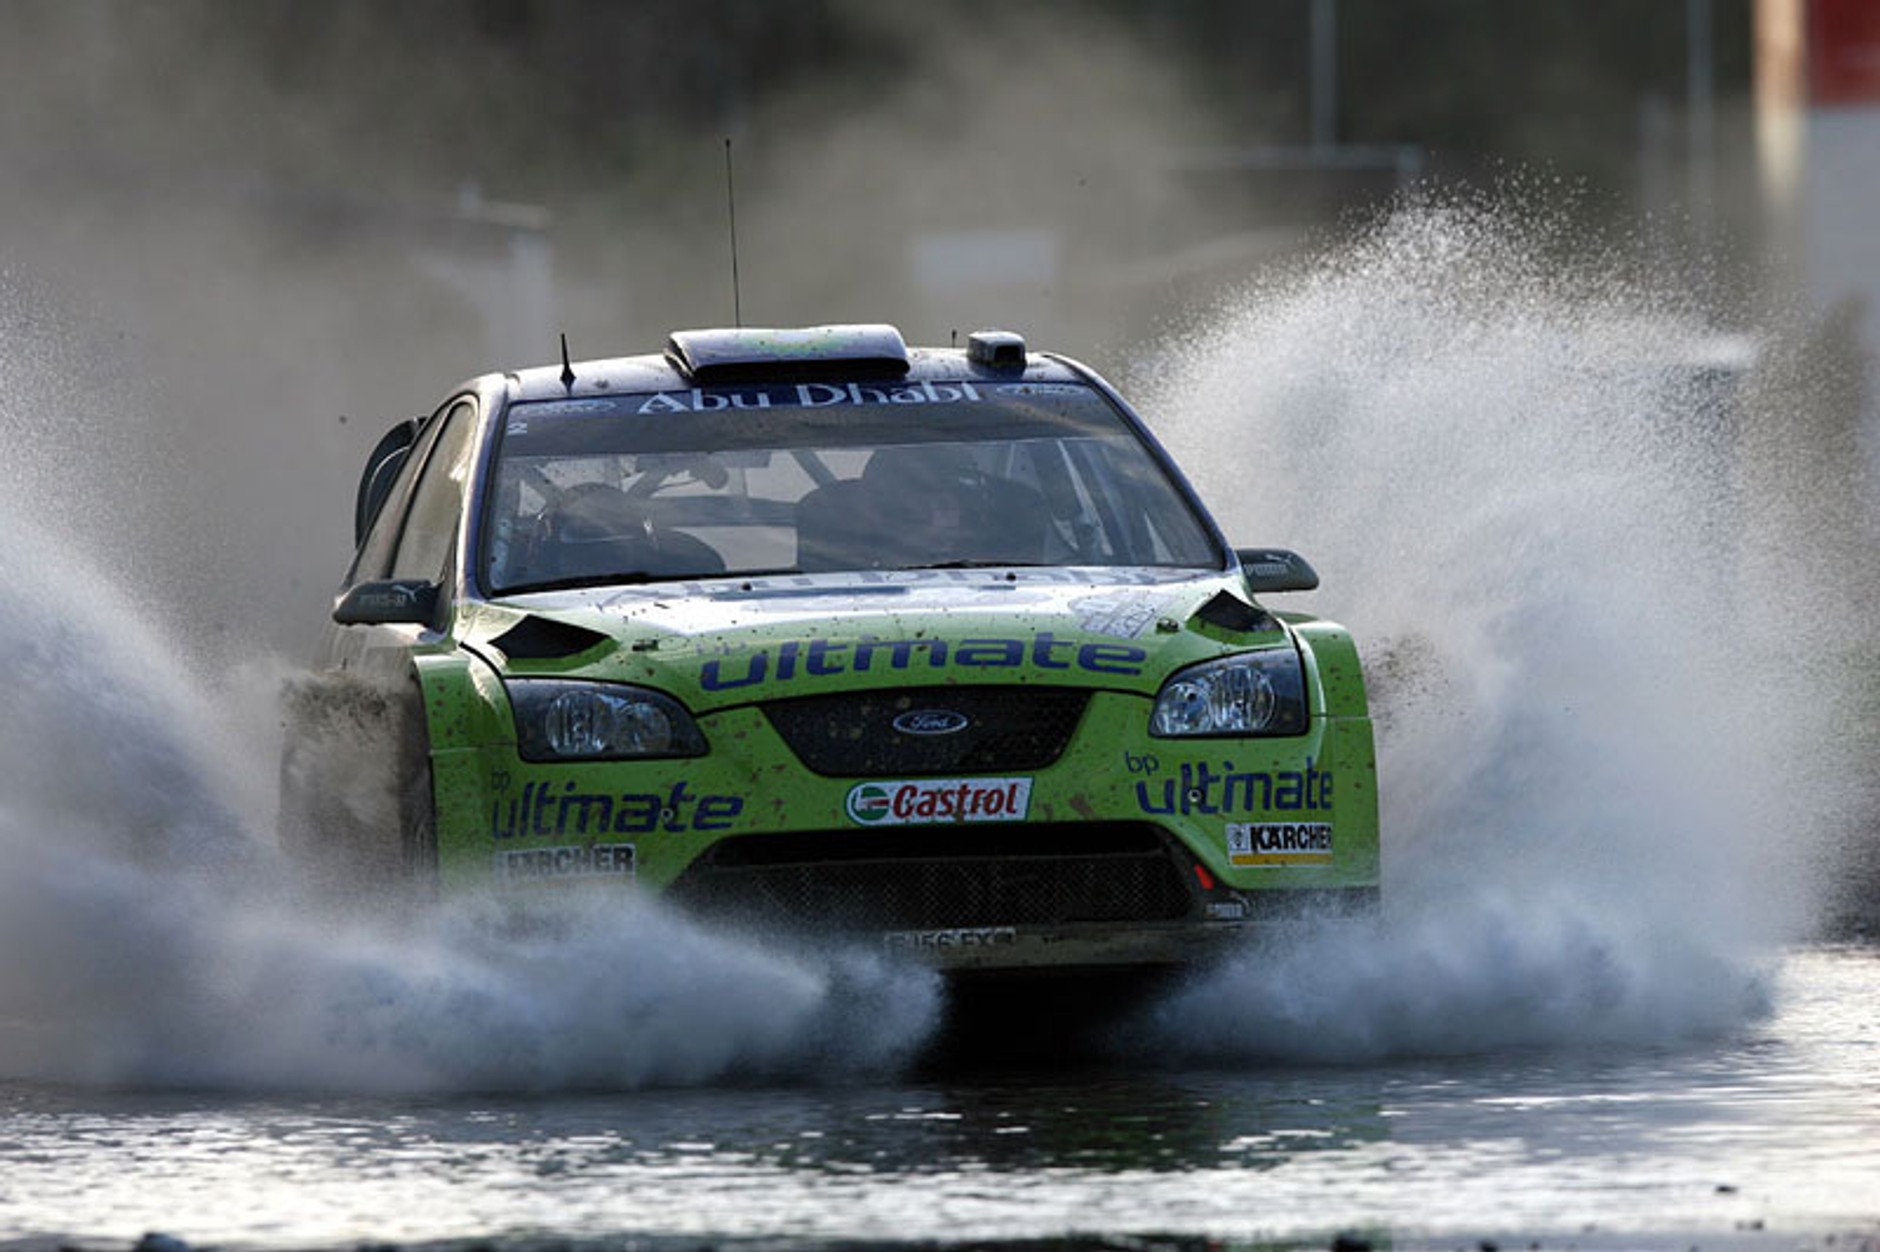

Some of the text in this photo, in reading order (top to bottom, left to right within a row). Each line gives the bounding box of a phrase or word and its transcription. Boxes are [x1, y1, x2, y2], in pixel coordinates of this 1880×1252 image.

[638, 388, 771, 415] Abu
[796, 380, 981, 408] Dhabi
[701, 631, 1147, 691] ultimate
[909, 711, 951, 734] Ford
[1125, 750, 1160, 776] bp
[893, 782, 1018, 818] Castrol
[1136, 755, 1334, 816] ultimate
[490, 779, 745, 839] ultimate
